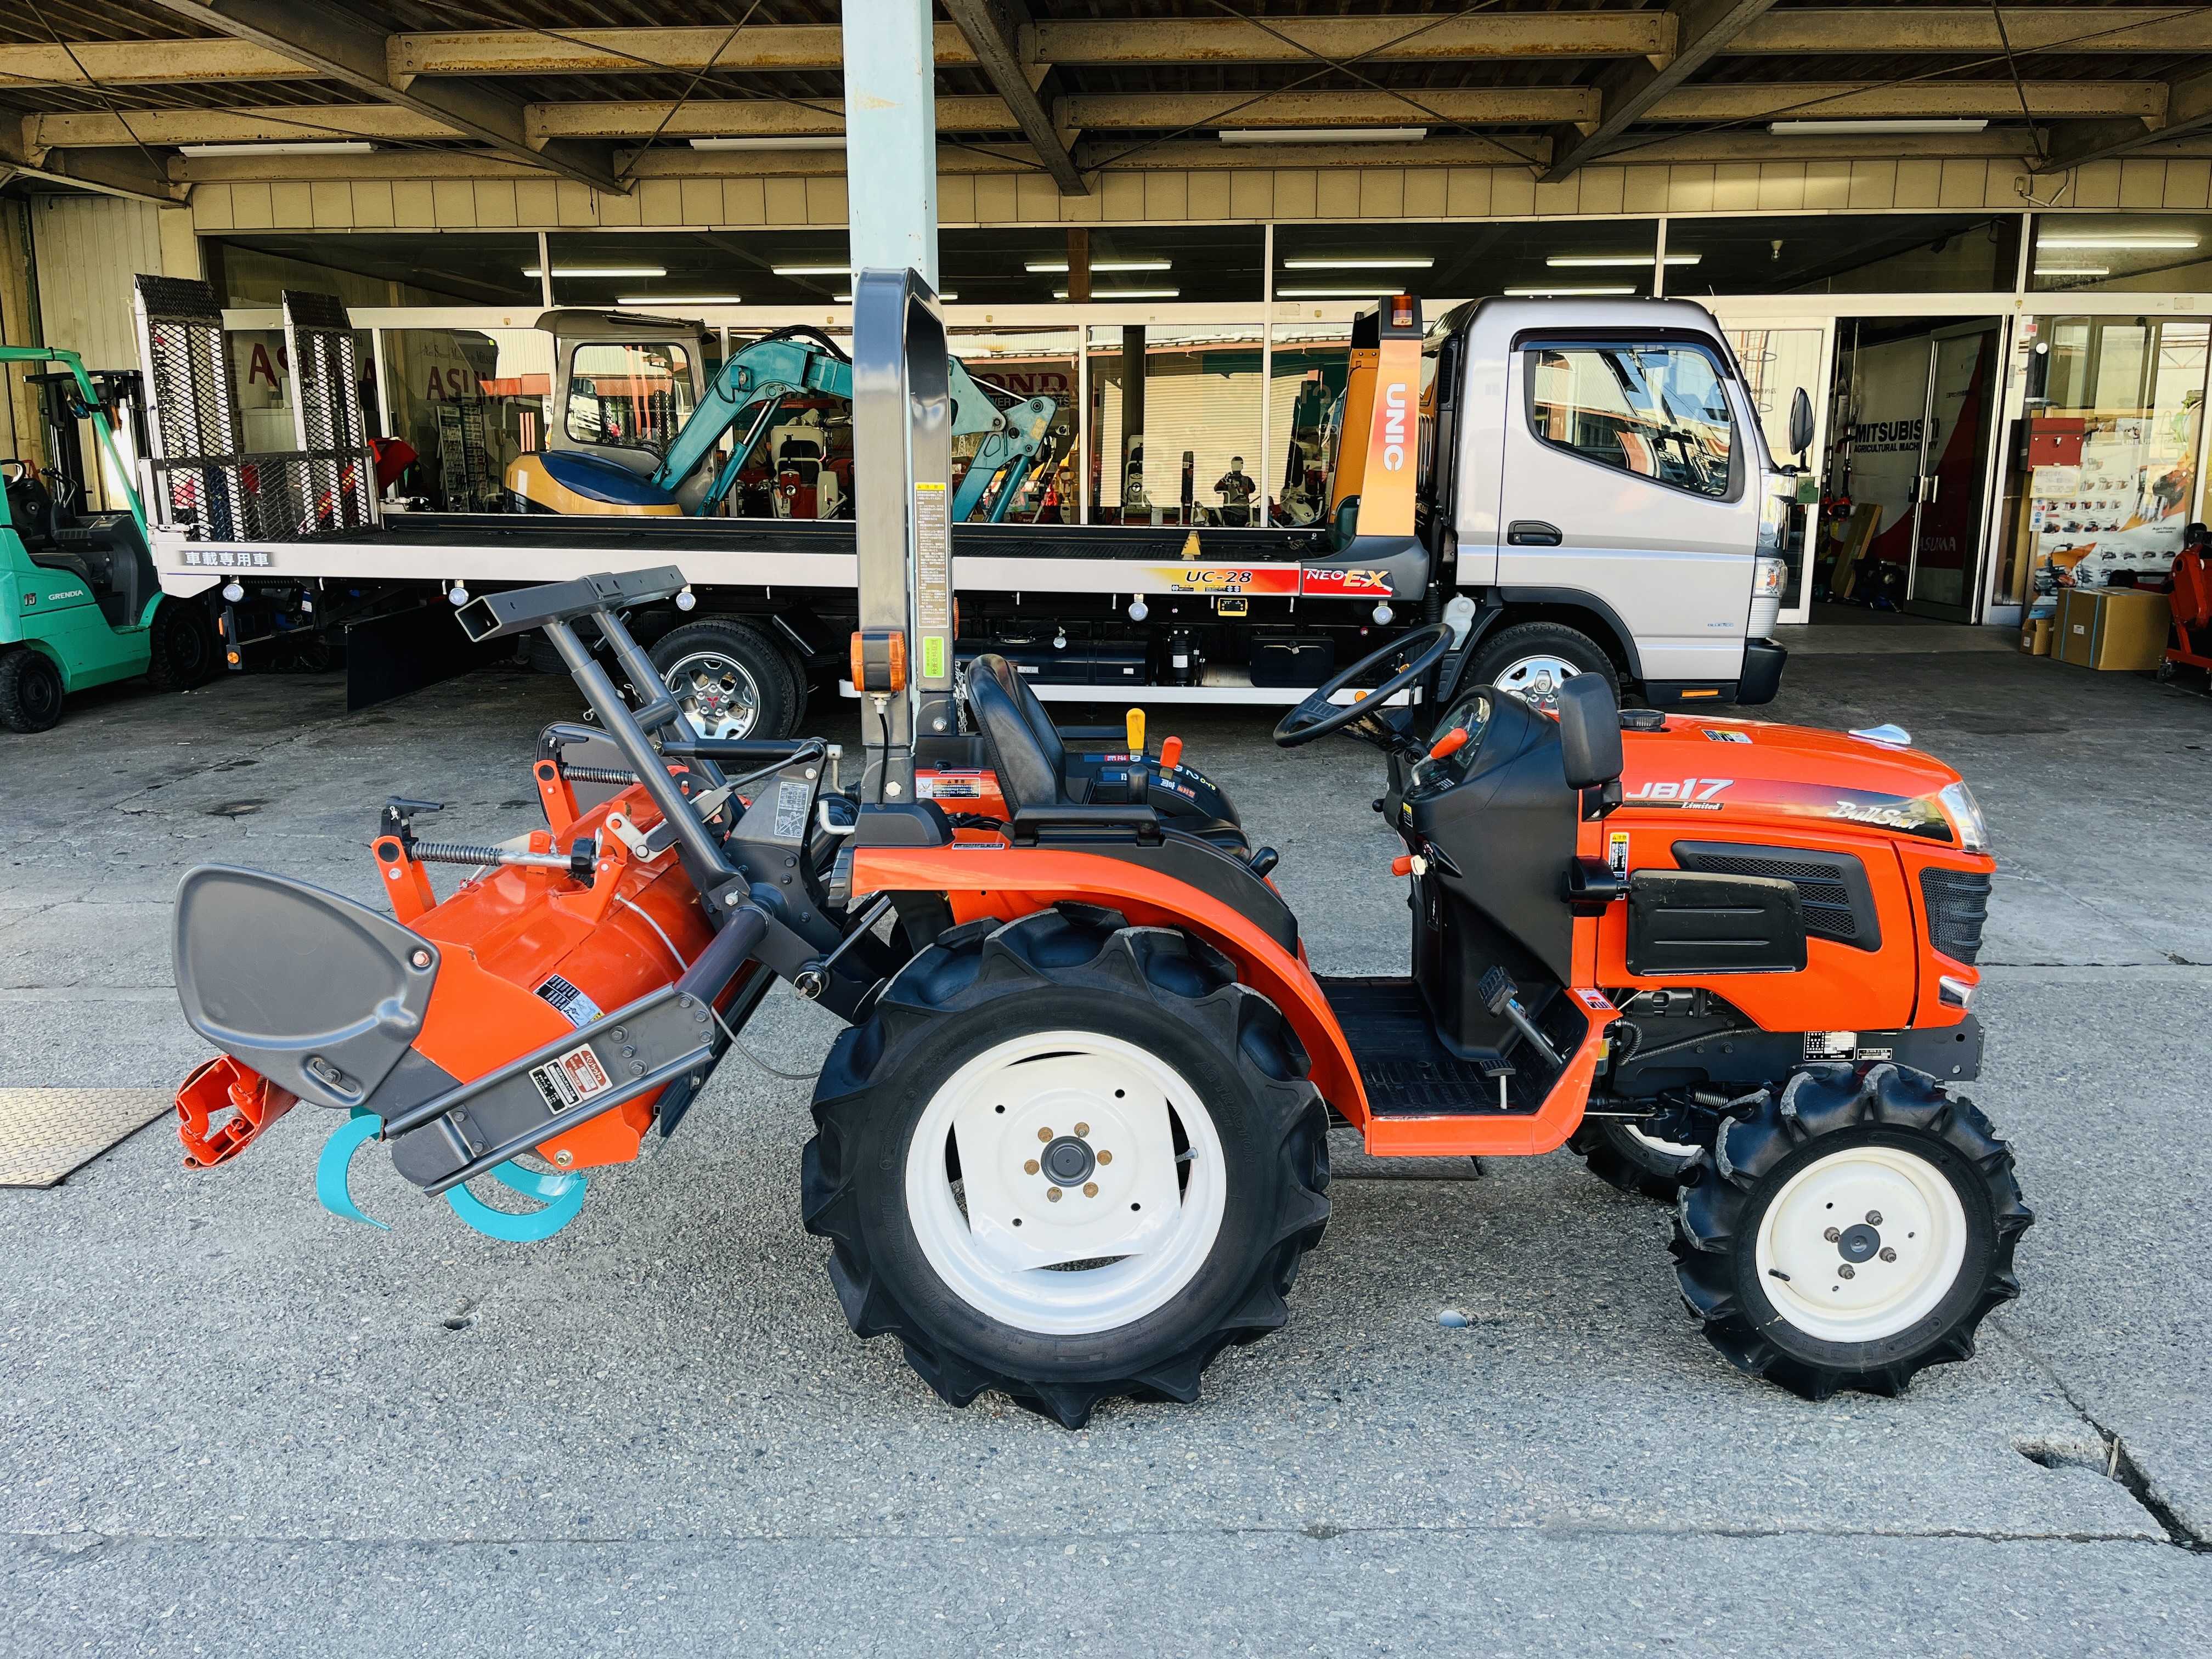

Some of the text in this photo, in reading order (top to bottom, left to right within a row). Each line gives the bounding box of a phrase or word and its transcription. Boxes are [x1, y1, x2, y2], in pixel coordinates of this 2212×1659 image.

[1383, 383, 1406, 471] UNIC
[1855, 418, 1940, 443] MITSUBISI
[1854, 443, 1898, 453] AGRICULTURAL
[185, 551, 269, 567] 車載専用車
[1186, 571, 1252, 583] UC-28
[1306, 569, 1390, 588] NEO EX
[24, 592, 36, 606] 15
[1624, 778, 1734, 800] JB17
[1681, 802, 1720, 810] Limited
[585, 1054, 602, 1081] Kubota
